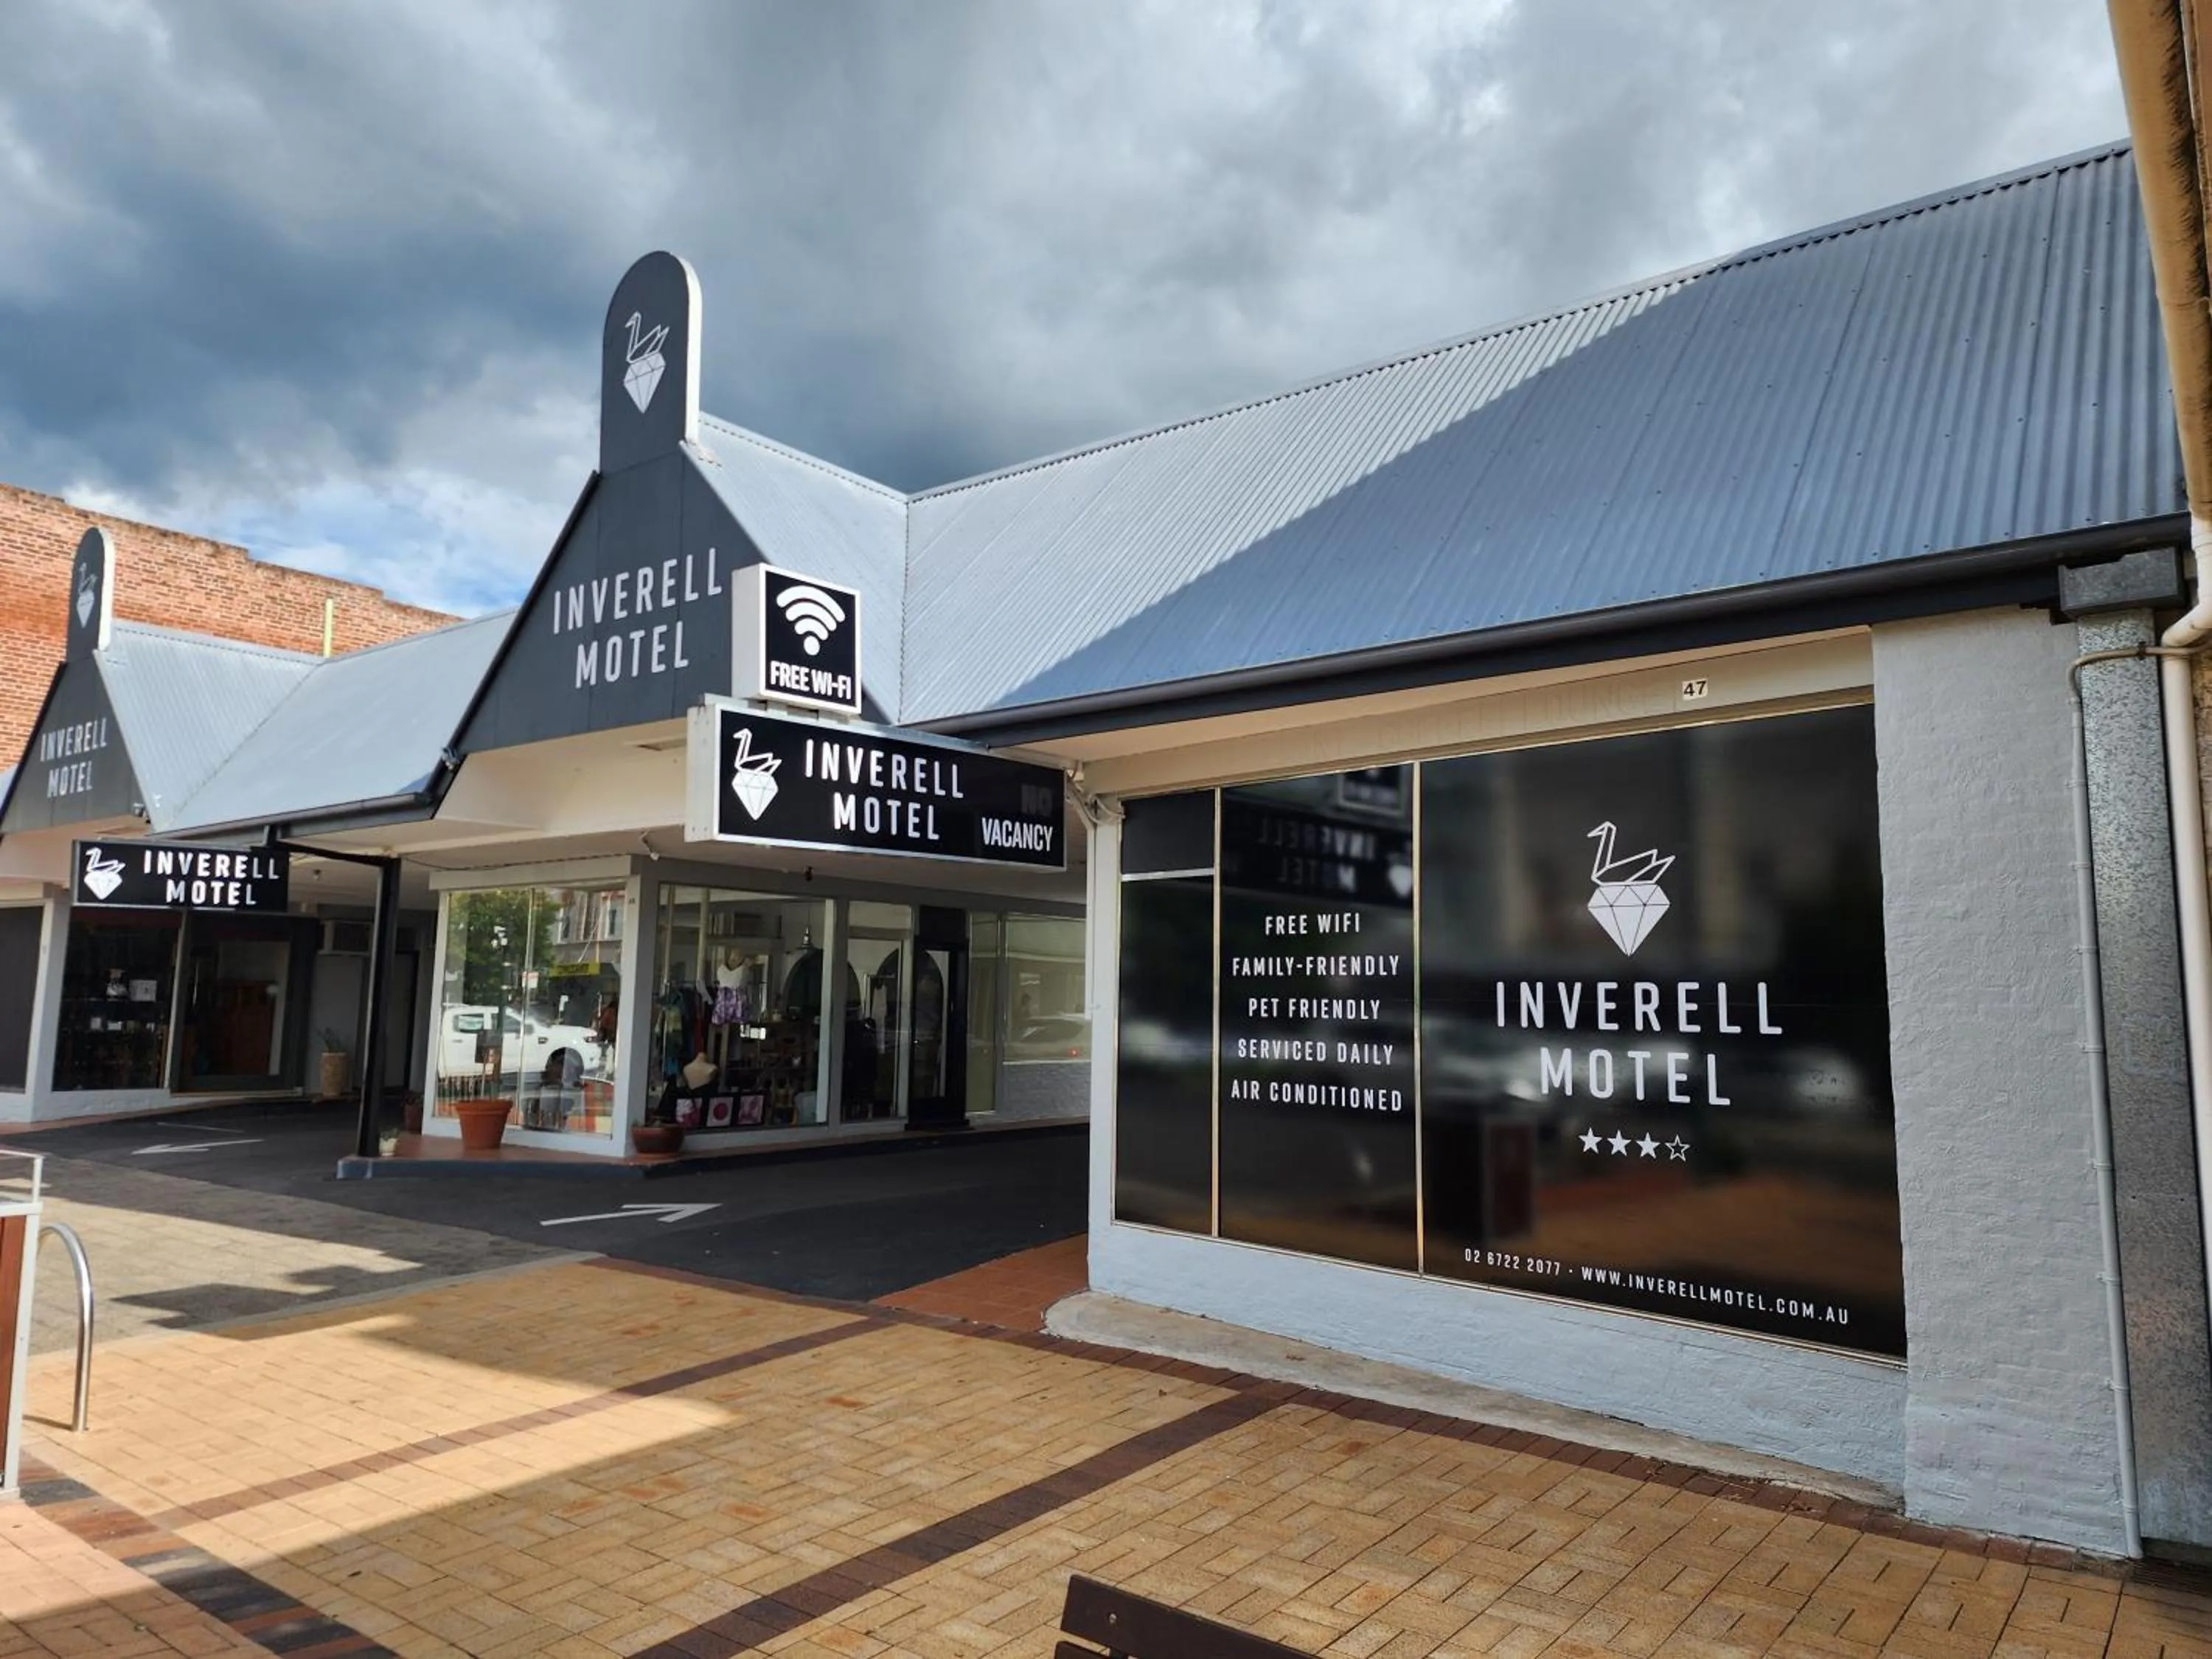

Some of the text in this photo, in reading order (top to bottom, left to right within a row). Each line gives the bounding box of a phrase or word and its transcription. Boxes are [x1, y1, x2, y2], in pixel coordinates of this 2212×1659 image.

[554, 548, 722, 634] INVERELL
[576, 621, 689, 688] MOTEL
[770, 660, 852, 700] FREE WI-FI
[1683, 680, 1706, 697] 47
[40, 717, 107, 762] INVERELL
[46, 760, 93, 799] MOTEL
[804, 739, 964, 799] INVERELL
[833, 792, 939, 840] MOTEL
[981, 817, 1053, 852] VACANCY
[144, 849, 279, 879] INVERELL
[165, 878, 257, 906] MOTEL
[1265, 912, 1360, 935] FREE WIFI
[1233, 955, 1399, 976] FAMILY-FRIENDLY
[1249, 998, 1380, 1020] PET FRIENDLY
[1497, 981, 1782, 1034] INVERELL
[1238, 1038, 1393, 1065] SERVICED DAILY
[1231, 1079, 1402, 1111] AIR CONDITIONED
[1540, 1048, 1730, 1105] MOTEL
[1465, 1248, 1848, 1324] 02 6722 2077 WWW.INVERELLMOTEL.COM.AU
